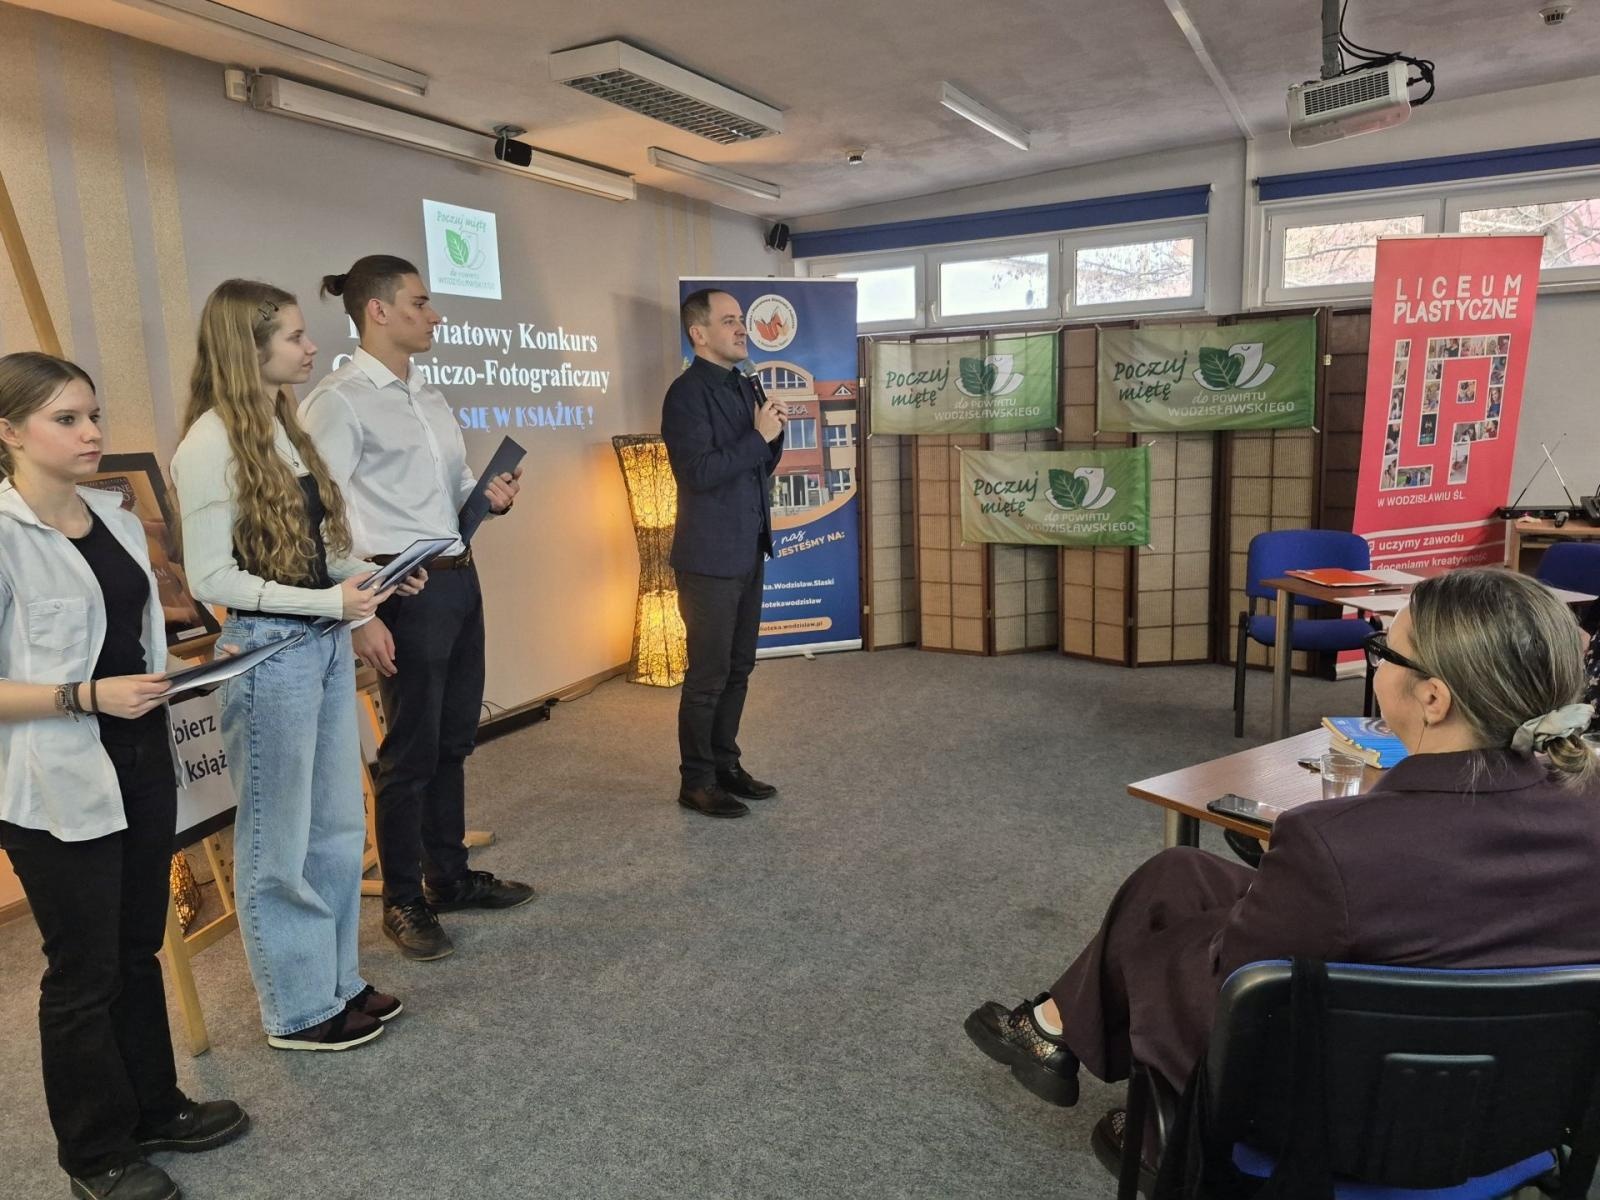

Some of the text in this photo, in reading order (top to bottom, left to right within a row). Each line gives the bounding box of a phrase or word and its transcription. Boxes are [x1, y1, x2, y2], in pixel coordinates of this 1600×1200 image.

[1396, 274, 1522, 301] LICEUM
[1393, 297, 1519, 325] PLASTYCZNE
[432, 316, 598, 354] wiatowy Konkurs
[409, 356, 610, 394] niczo-Fotograficzny
[886, 360, 949, 391] Poczuj
[1113, 350, 1187, 383] Poczuj
[891, 389, 937, 408] miętę
[1119, 381, 1171, 403] miętę
[1212, 391, 1266, 404] POWIATU
[459, 406, 490, 432] SIĘ
[493, 406, 511, 427] W
[1168, 401, 1295, 417] WODZISŁAWSKIEGO
[973, 471, 1038, 502] Poczuj
[1377, 498, 1385, 508] W
[1387, 491, 1451, 506] WODZISŁAWIU
[981, 499, 1026, 517] miętę
[777, 536, 825, 558] JESTEŚMY
[827, 531, 845, 542] NA:
[1379, 533, 1464, 551] uczymy zawodu
[763, 578, 835, 591] ka.Wodzislaw.Slaski
[762, 598, 822, 609] iotekawodzislaw
[173, 715, 217, 745] bierz
[185, 749, 228, 783] książ
